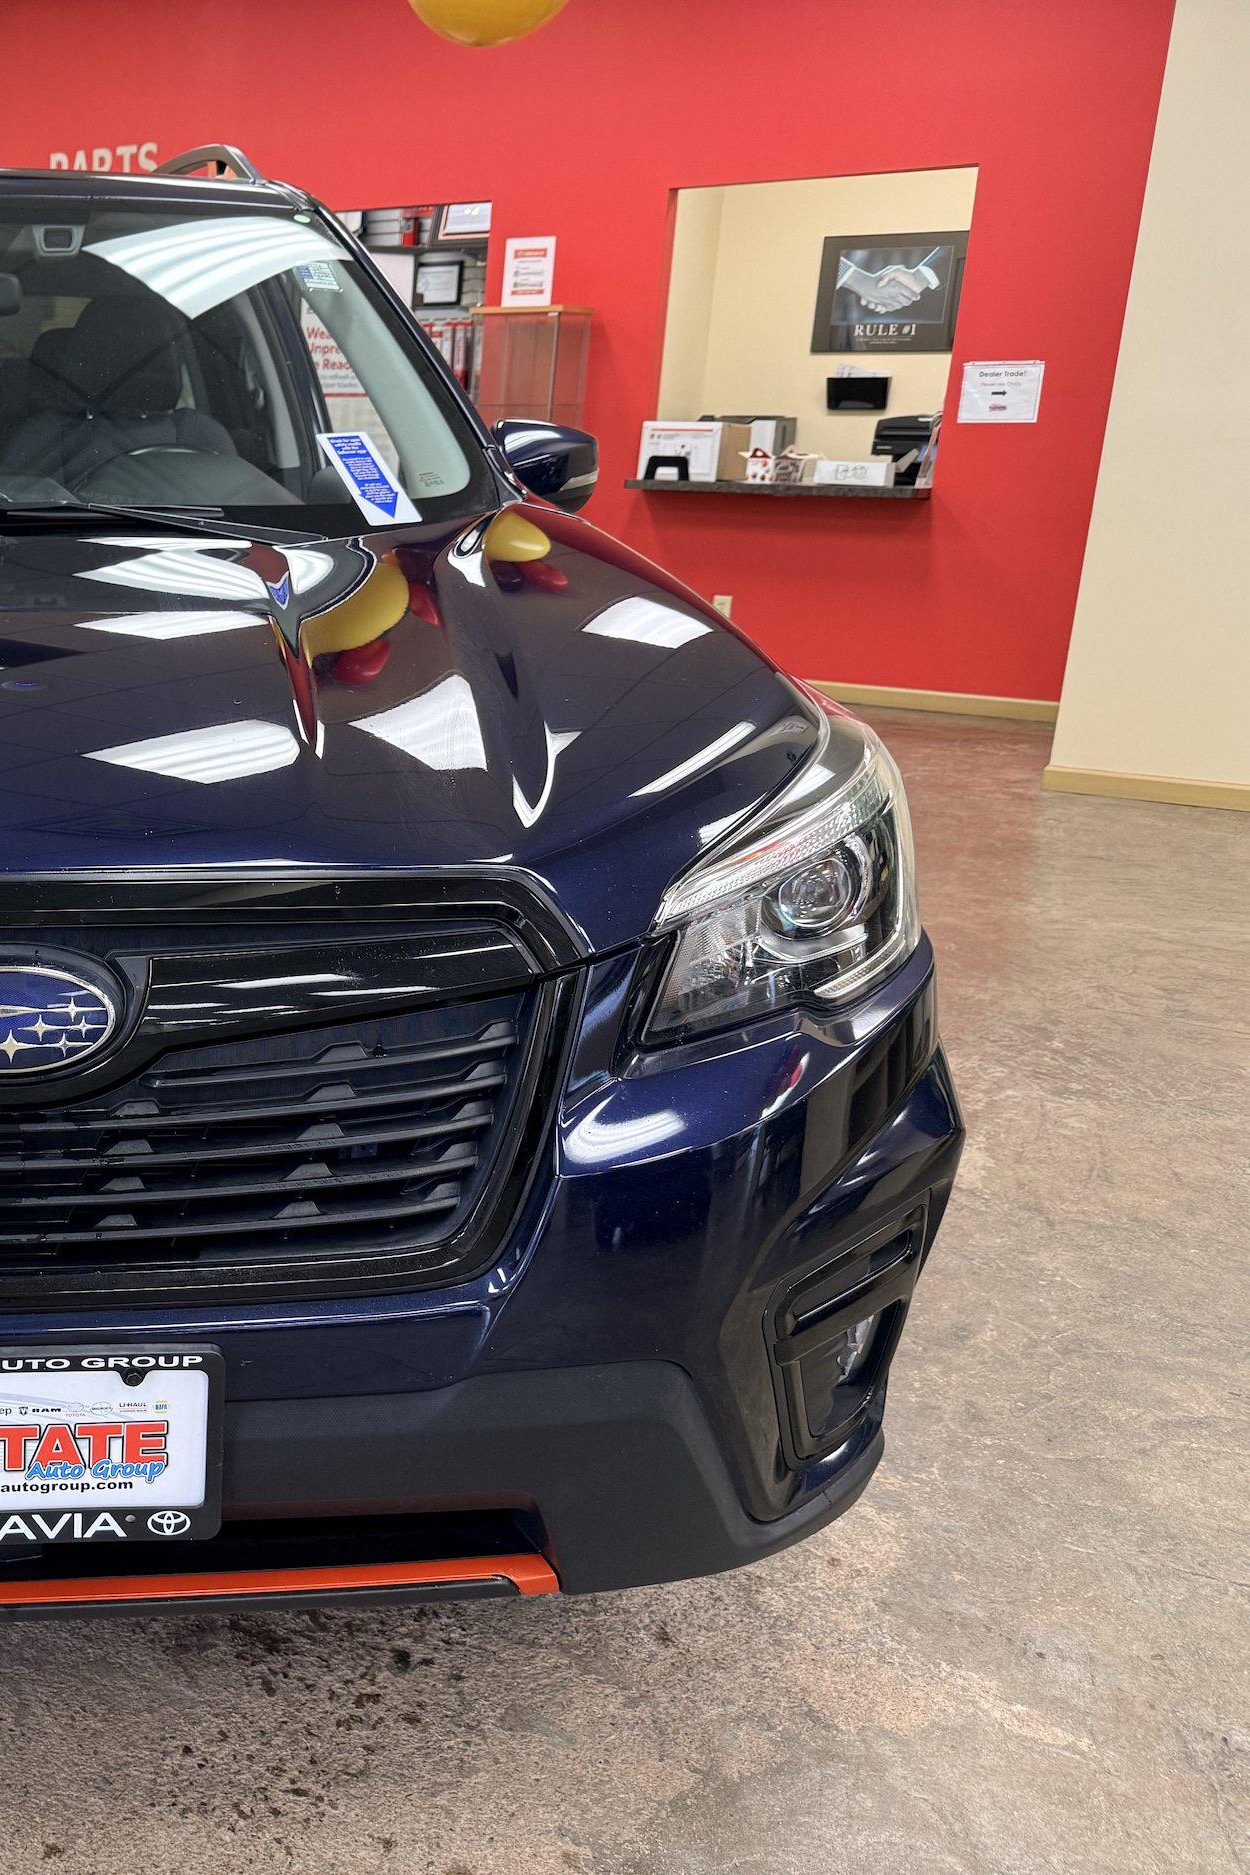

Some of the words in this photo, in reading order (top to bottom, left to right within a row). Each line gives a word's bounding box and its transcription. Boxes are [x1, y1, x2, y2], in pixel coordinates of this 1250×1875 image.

[854, 323, 899, 336] RULE
[902, 323, 917, 336] #1
[80, 1355, 203, 1369] GROUP
[25, 1460, 85, 1481] Auto
[90, 1457, 167, 1483] Group
